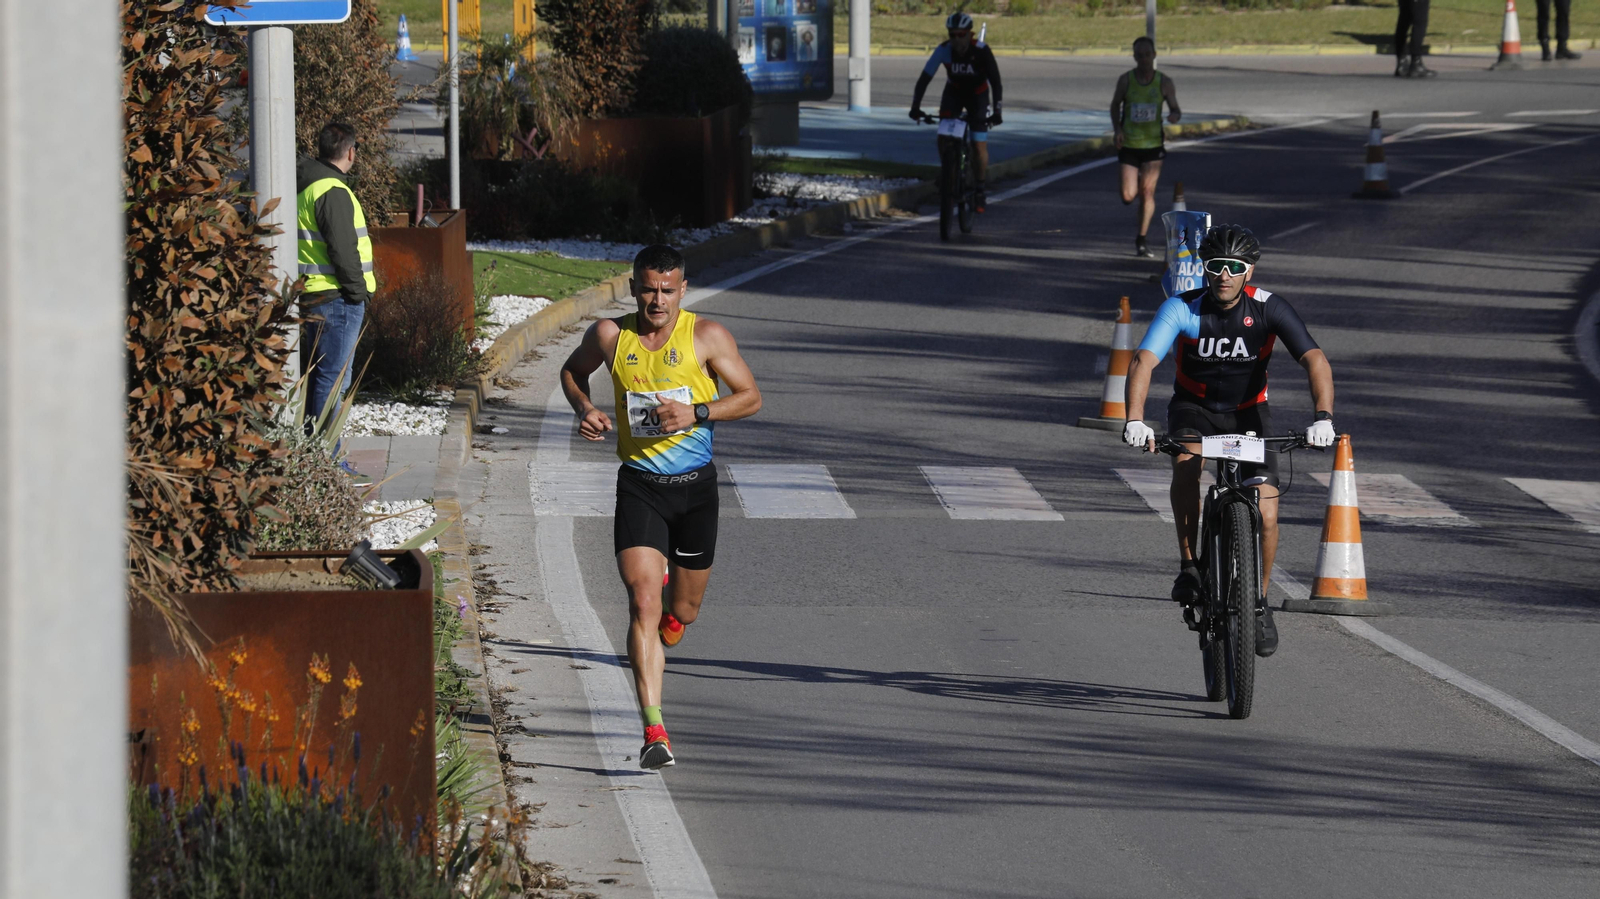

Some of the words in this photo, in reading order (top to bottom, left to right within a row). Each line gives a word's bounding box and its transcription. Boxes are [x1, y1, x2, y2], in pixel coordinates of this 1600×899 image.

[951, 63, 974, 74] UCA
[1198, 337, 1250, 358] UCA
[669, 472, 699, 483] PRO
